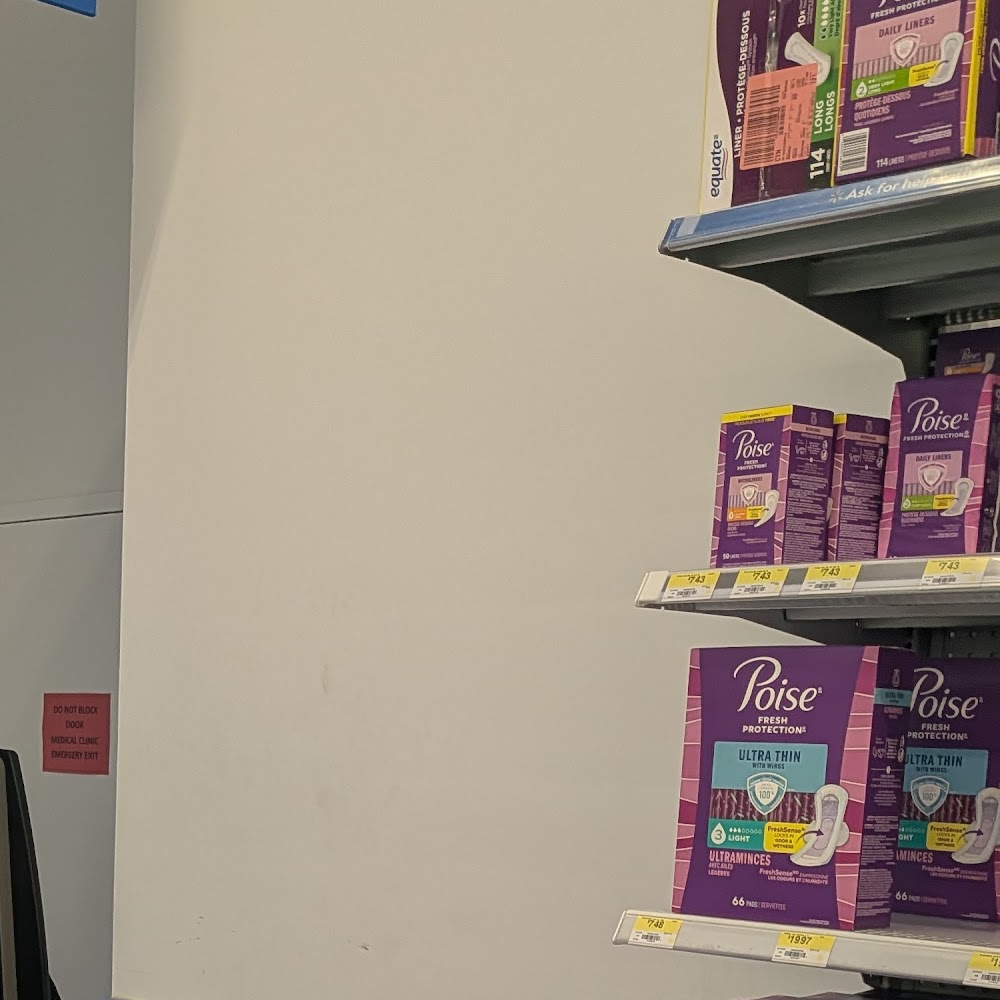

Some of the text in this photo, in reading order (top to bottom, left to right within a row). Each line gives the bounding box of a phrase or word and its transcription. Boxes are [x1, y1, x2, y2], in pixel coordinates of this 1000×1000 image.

[871, 0, 939, 19] FRESH PROTECT
[879, 16, 935, 38] DAILY LINERS
[734, 10, 751, 159] LINER PROTÈGE-DESSOUS
[859, 86, 865, 94] 2
[814, 100, 825, 134] LONG
[825, 91, 836, 133] LONGS
[711, 139, 723, 198] equate
[810, 148, 826, 180] 114
[876, 158, 889, 168] 114
[846, 185, 873, 200] Ask
[877, 182, 899, 195] for
[907, 397, 963, 434] Poise
[903, 432, 964, 442] FRESH PROTECTION
[732, 430, 772, 460] Poise
[734, 656, 818, 712] Poise
[910, 667, 978, 719] Poise
[54, 706, 99, 715] DO NOT BLOCK
[66, 720, 84, 729] DOOR
[758, 717, 788, 725] FRESH
[922, 723, 950, 731] FRESH
[742, 726, 802, 734] PROTECTION
[908, 732, 964, 740] PROTECTION
[51, 736, 77, 745] MEDICAL
[84, 752, 99, 760] EXIT
[739, 750, 801, 763] ULTRA THIN
[937, 755, 963, 767] THIN
[714, 830, 723, 840] 3
[768, 826, 802, 834] FreshSense
[710, 850, 772, 866] ULTRAMINCES
[896, 891, 908, 900] 66
[732, 896, 746, 907] 66
[746, 900, 758, 908] PADS
